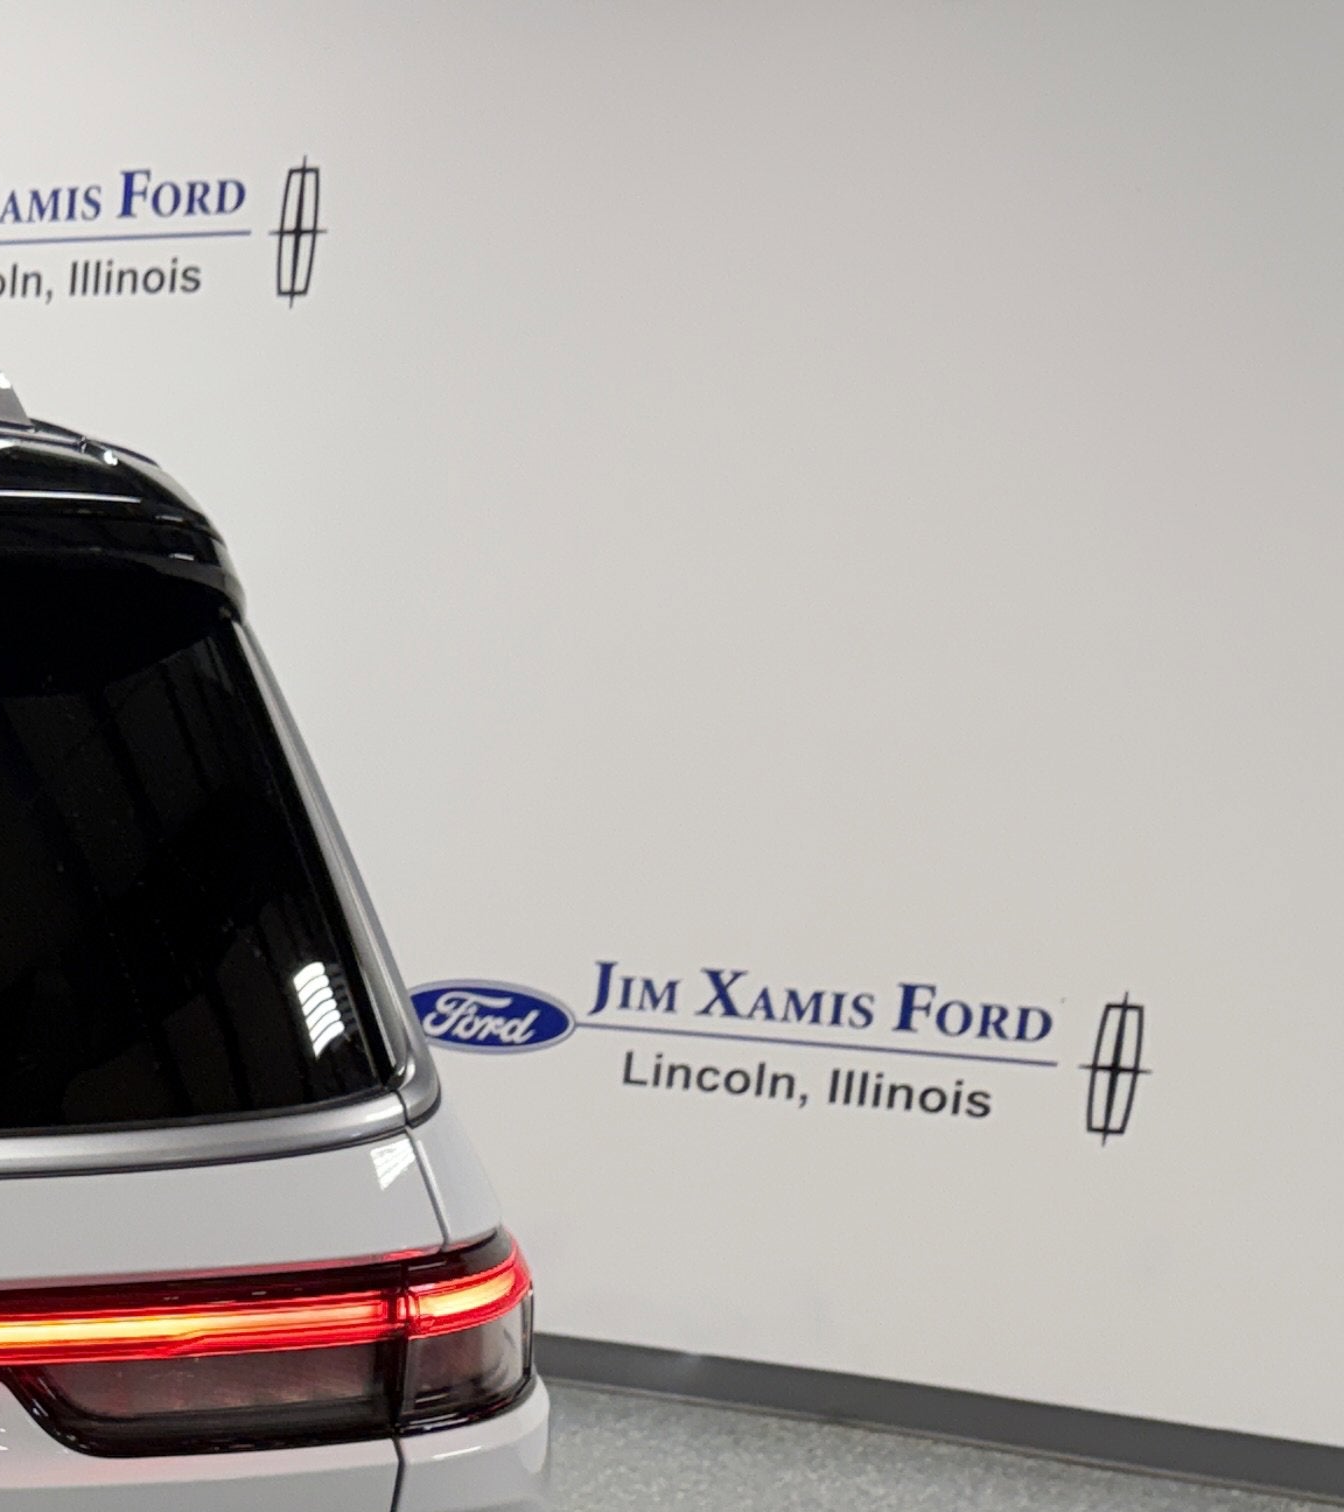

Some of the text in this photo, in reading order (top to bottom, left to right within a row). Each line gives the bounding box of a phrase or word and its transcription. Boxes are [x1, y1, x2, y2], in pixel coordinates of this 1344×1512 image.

[117, 169, 247, 218] FORD
[69, 258, 202, 297] Illinois
[422, 990, 541, 1044] Ford
[588, 961, 1054, 1042] JIM XAMIS FORD
[623, 1051, 993, 1118] Lincoln, Illinois
